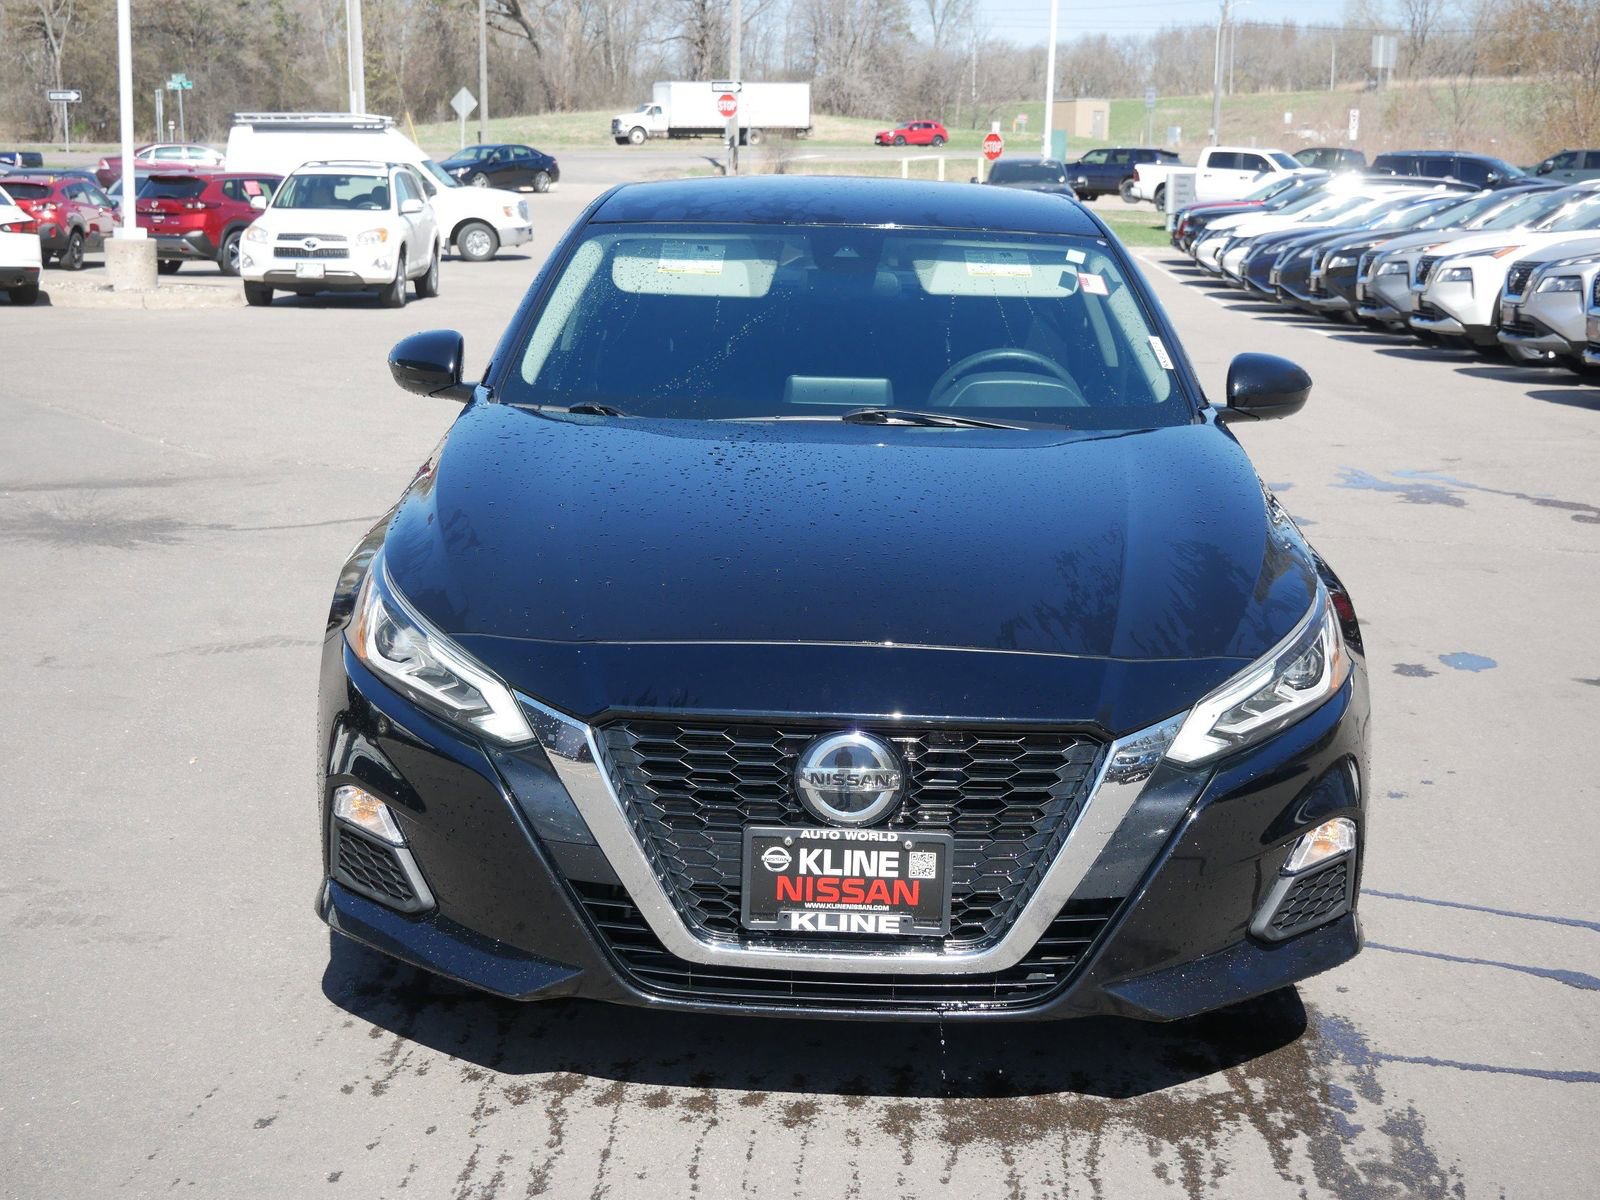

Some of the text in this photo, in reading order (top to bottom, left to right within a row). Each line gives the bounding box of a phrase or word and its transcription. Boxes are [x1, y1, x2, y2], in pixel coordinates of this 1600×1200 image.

[719, 101, 736, 111] STOP
[984, 141, 1002, 153] STOP
[810, 773, 890, 786] NISSAN
[800, 830, 898, 842] AUTO WORLD
[799, 848, 899, 877] KLINE
[776, 875, 919, 906] NISSAN
[804, 902, 889, 911] WWW.KLINENISSAN.COM
[790, 912, 900, 933] KLINE
